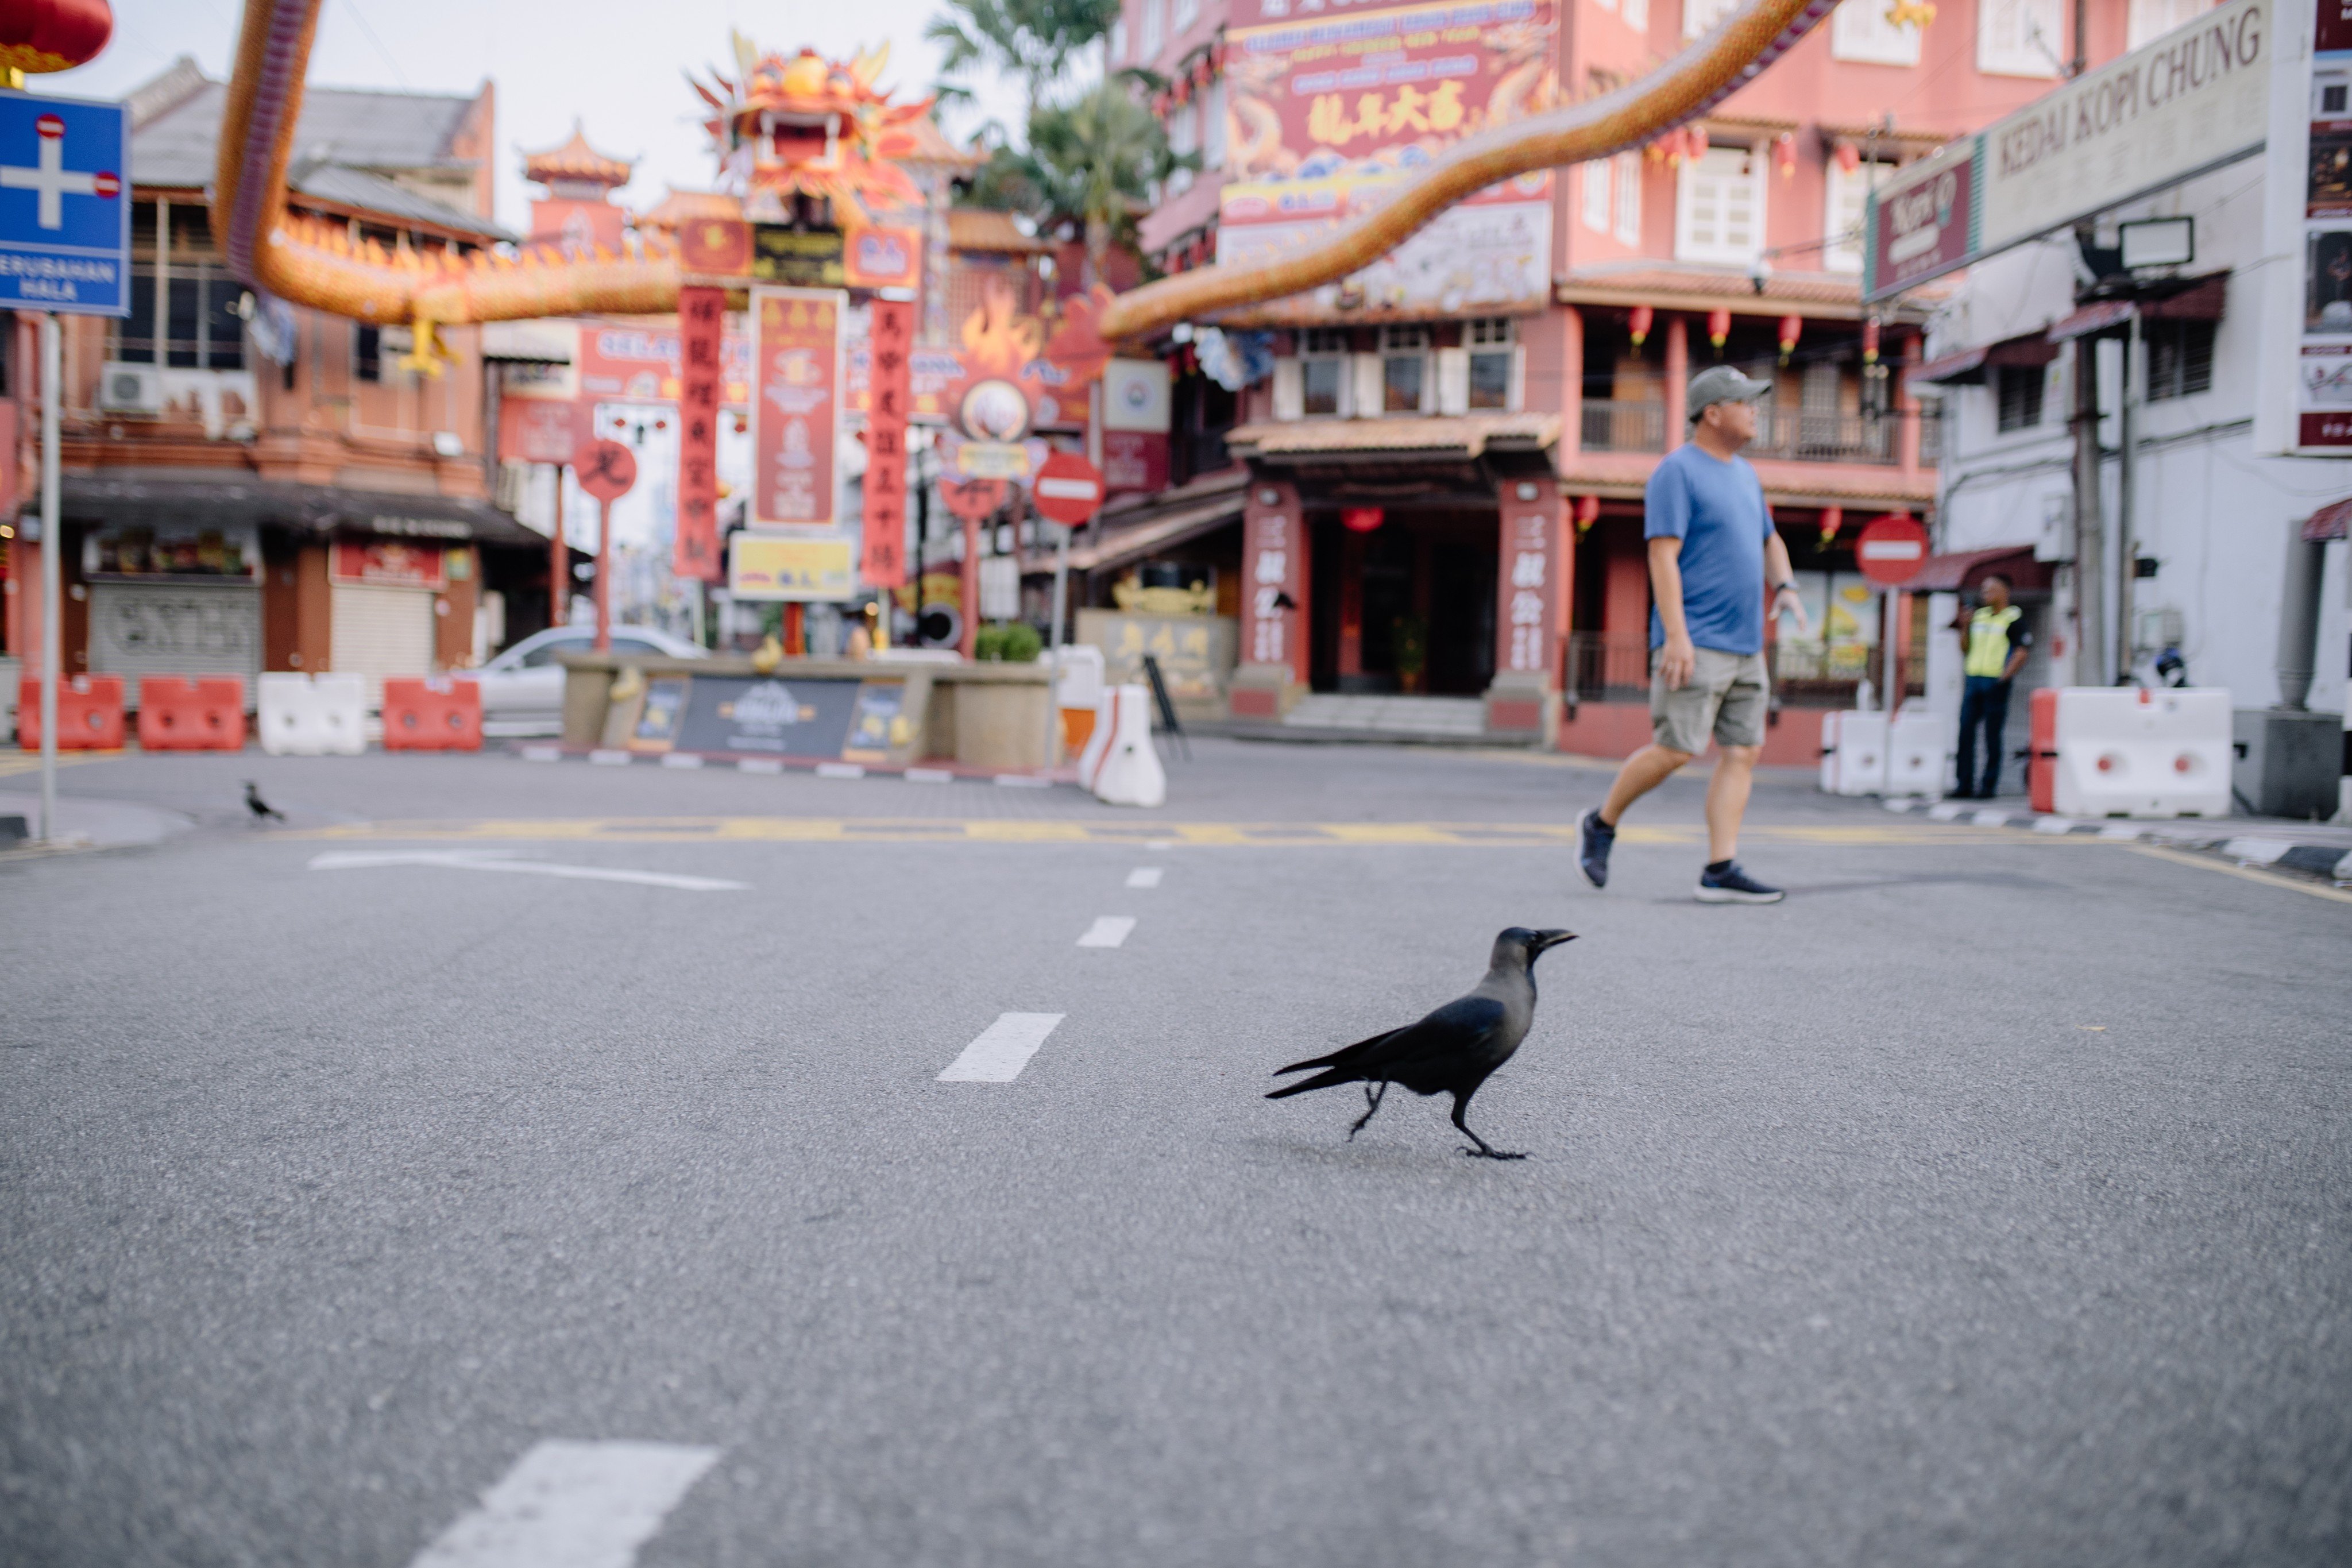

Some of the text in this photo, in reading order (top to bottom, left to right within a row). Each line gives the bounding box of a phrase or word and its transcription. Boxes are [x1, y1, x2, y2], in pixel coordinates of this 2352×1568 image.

[1999, 102, 2068, 183] KEDAI
[2074, 63, 2141, 146] KOPI
[2146, 5, 2261, 108] CHUNG
[0, 254, 114, 284] ERUBAHAN
[19, 277, 78, 301] HALA
